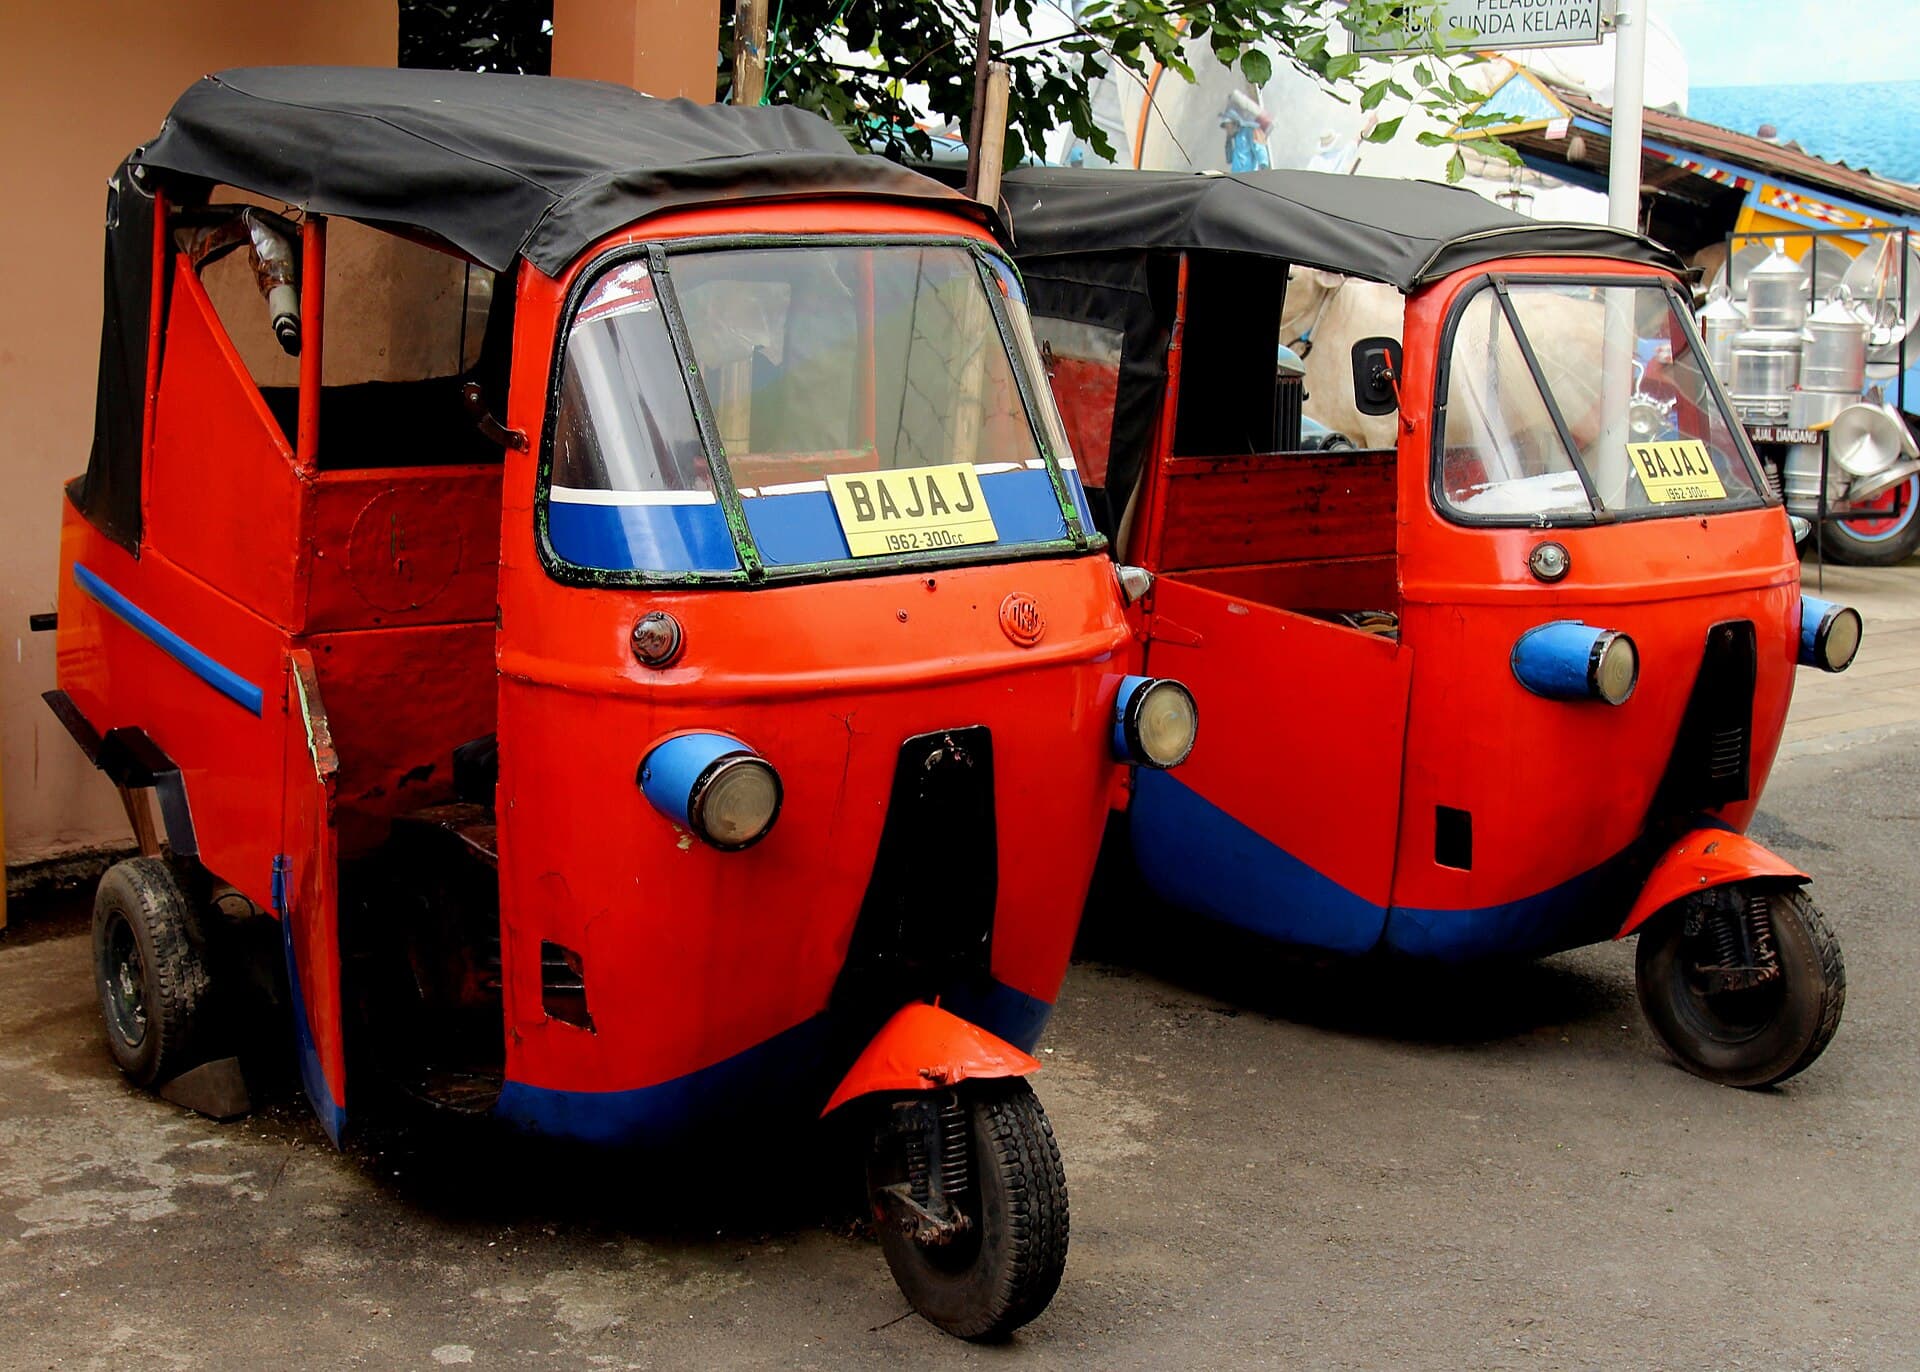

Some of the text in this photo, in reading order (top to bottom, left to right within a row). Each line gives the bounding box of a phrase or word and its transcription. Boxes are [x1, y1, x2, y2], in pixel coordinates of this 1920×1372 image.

[1477, 0, 1592, 10] PELAB
[1449, 8, 1592, 34] SUNDA KELAPA
[1752, 428, 1774, 442] JUAL
[1637, 446, 1709, 478] BAJAJ
[845, 471, 975, 522] BAJAJ
[885, 530, 965, 551] 1962-300cc
